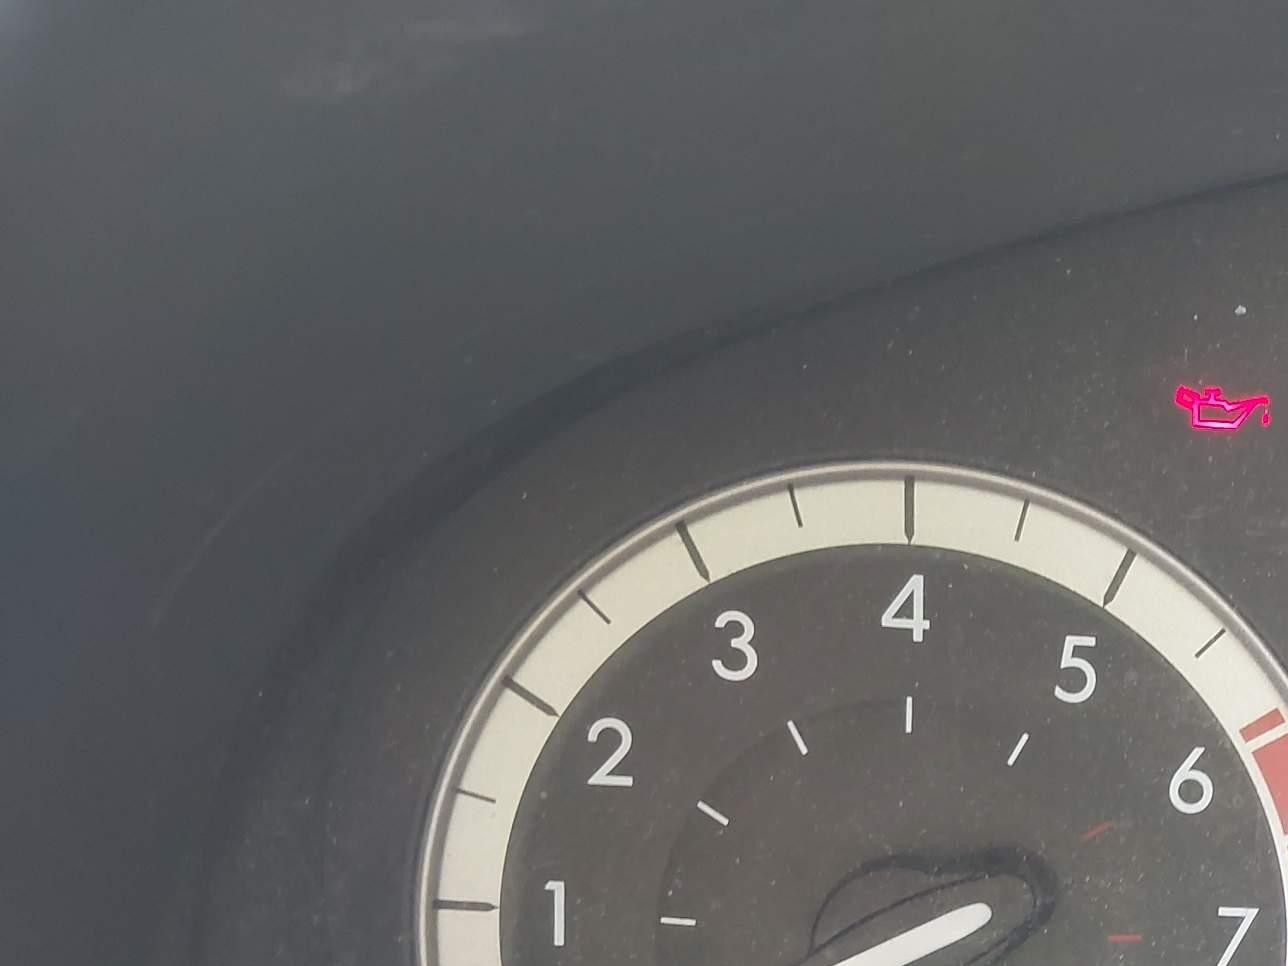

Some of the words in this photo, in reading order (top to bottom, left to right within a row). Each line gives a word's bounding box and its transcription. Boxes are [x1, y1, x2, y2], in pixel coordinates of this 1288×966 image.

[880, 574, 930, 642] 4
[712, 610, 758, 680] 3
[1054, 636, 1097, 703] 5
[587, 718, 634, 786] 2
[1170, 747, 1213, 813] 6
[544, 881, 566, 946] 1
